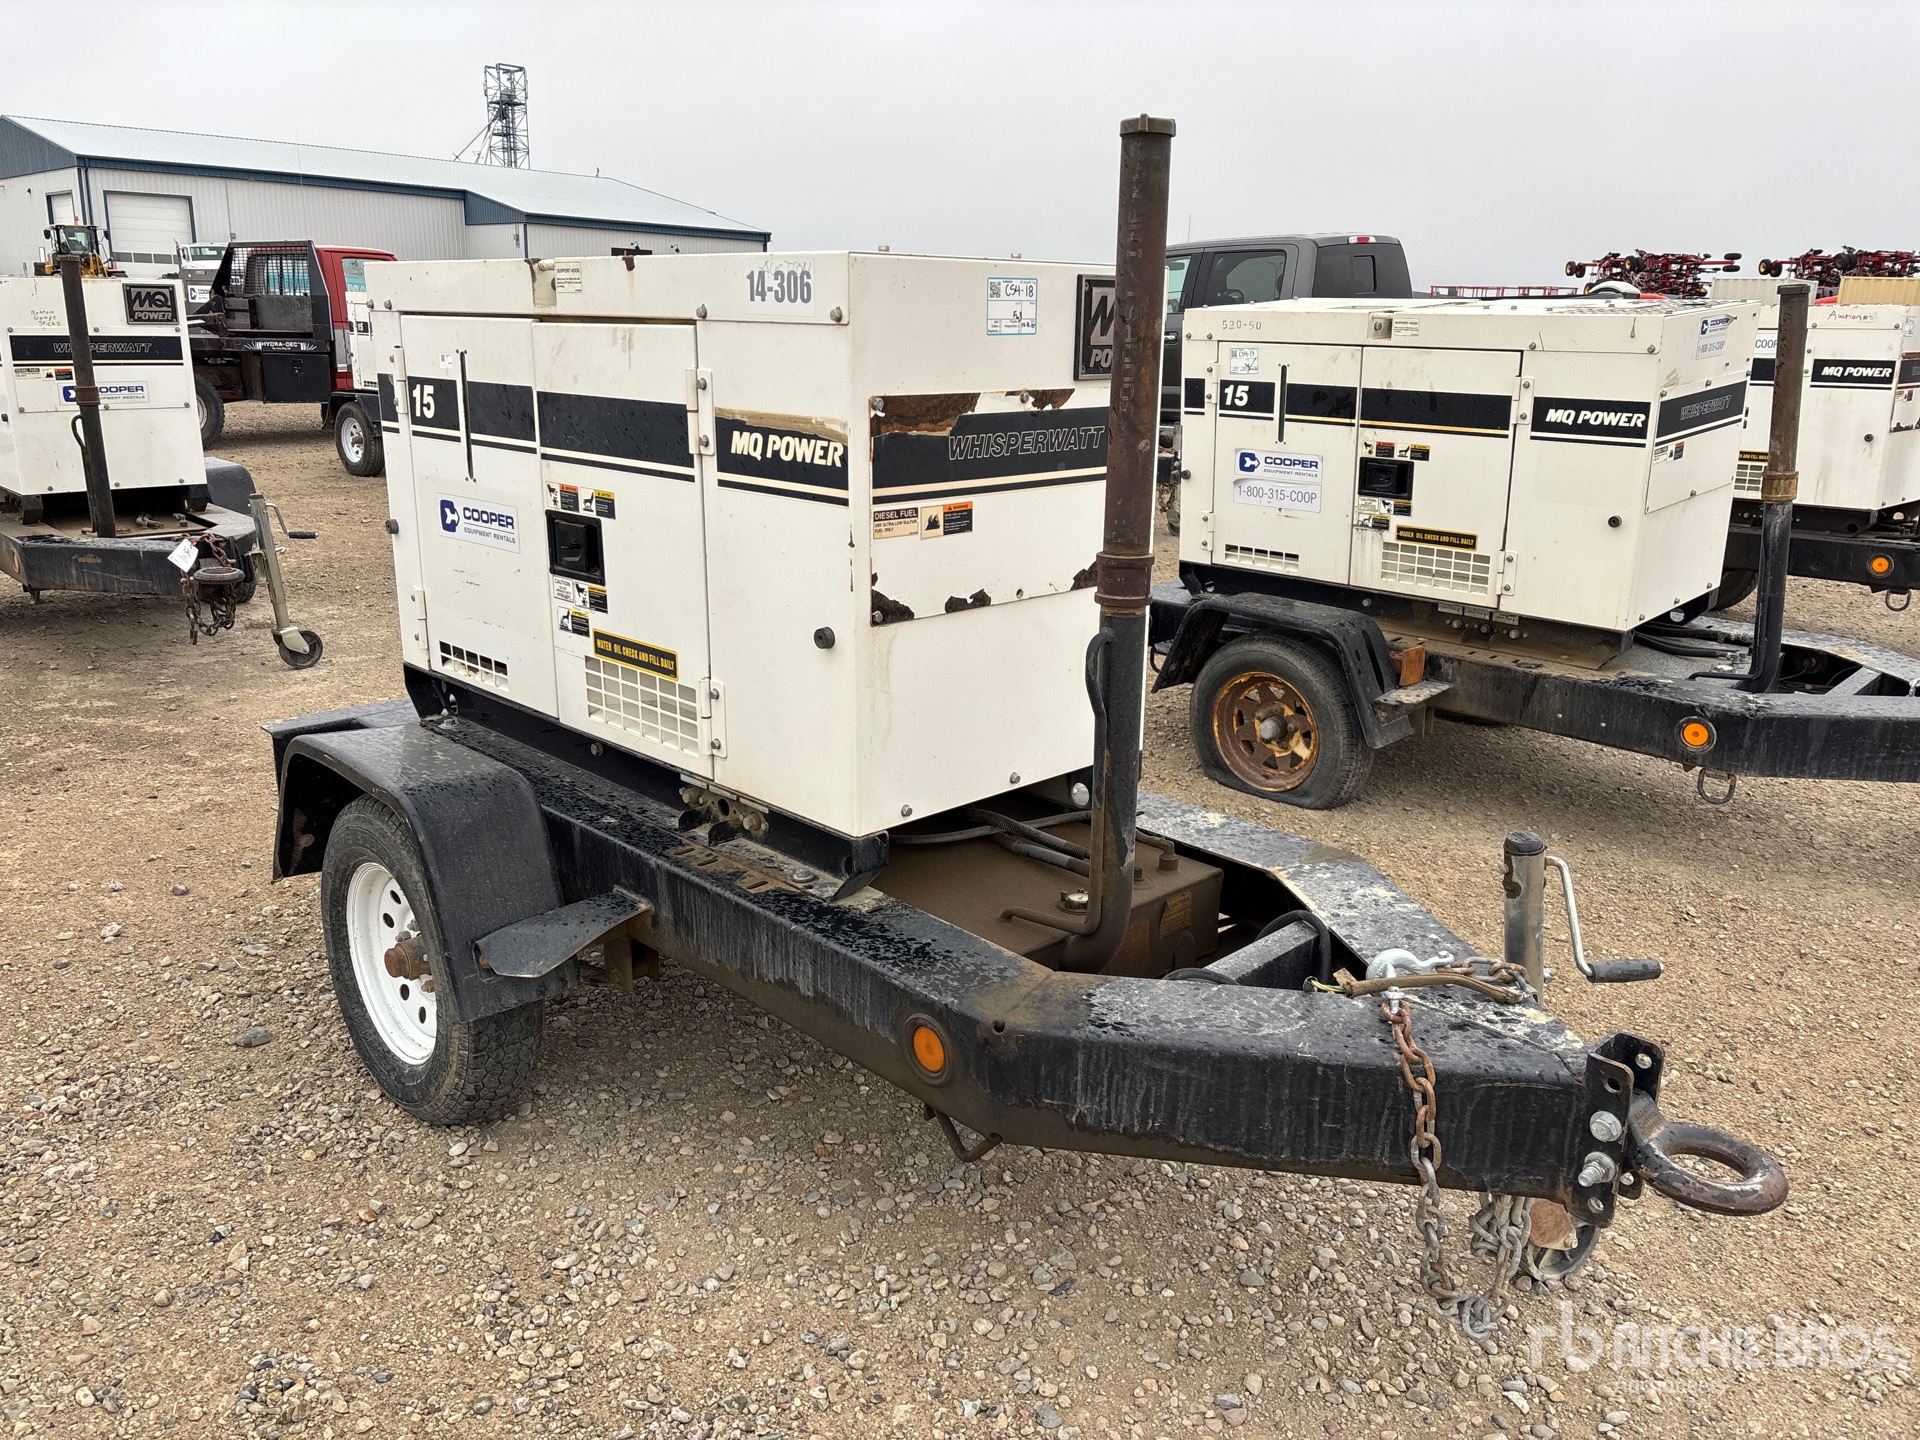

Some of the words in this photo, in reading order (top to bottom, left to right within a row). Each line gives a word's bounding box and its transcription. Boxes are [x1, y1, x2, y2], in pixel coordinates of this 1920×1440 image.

[746, 270, 812, 304] 14-306
[132, 291, 172, 308] MQ
[134, 311, 173, 320] POWER
[1222, 320, 1262, 330] 520-50
[1821, 366, 1843, 377] MQ
[1843, 367, 1893, 378] POWER
[412, 383, 435, 419] 15
[1224, 385, 1249, 407] 15
[1545, 408, 1577, 425] MQ
[1577, 411, 1647, 428] POWER
[731, 430, 763, 461] MQ
[766, 434, 844, 467] POWER
[949, 425, 1105, 460] WHISPERWATT
[1264, 456, 1319, 469] COOPER
[1238, 485, 1317, 504] 1-800-315-COOP
[463, 507, 514, 530] COOPER
[874, 510, 899, 520] DIESEL
[900, 509, 917, 518] FUEL
[464, 527, 492, 538] EQUIPMENT
[493, 533, 516, 544] RENTALS
[1440, 535, 1449, 543] AND
[1450, 536, 1460, 544] FILL
[596, 639, 612, 651] WATER
[613, 643, 622, 655] OIL
[622, 646, 638, 660] CHECK
[639, 651, 648, 663] AND
[649, 654, 660, 667] FILL
[660, 657, 675, 671] DAILY
